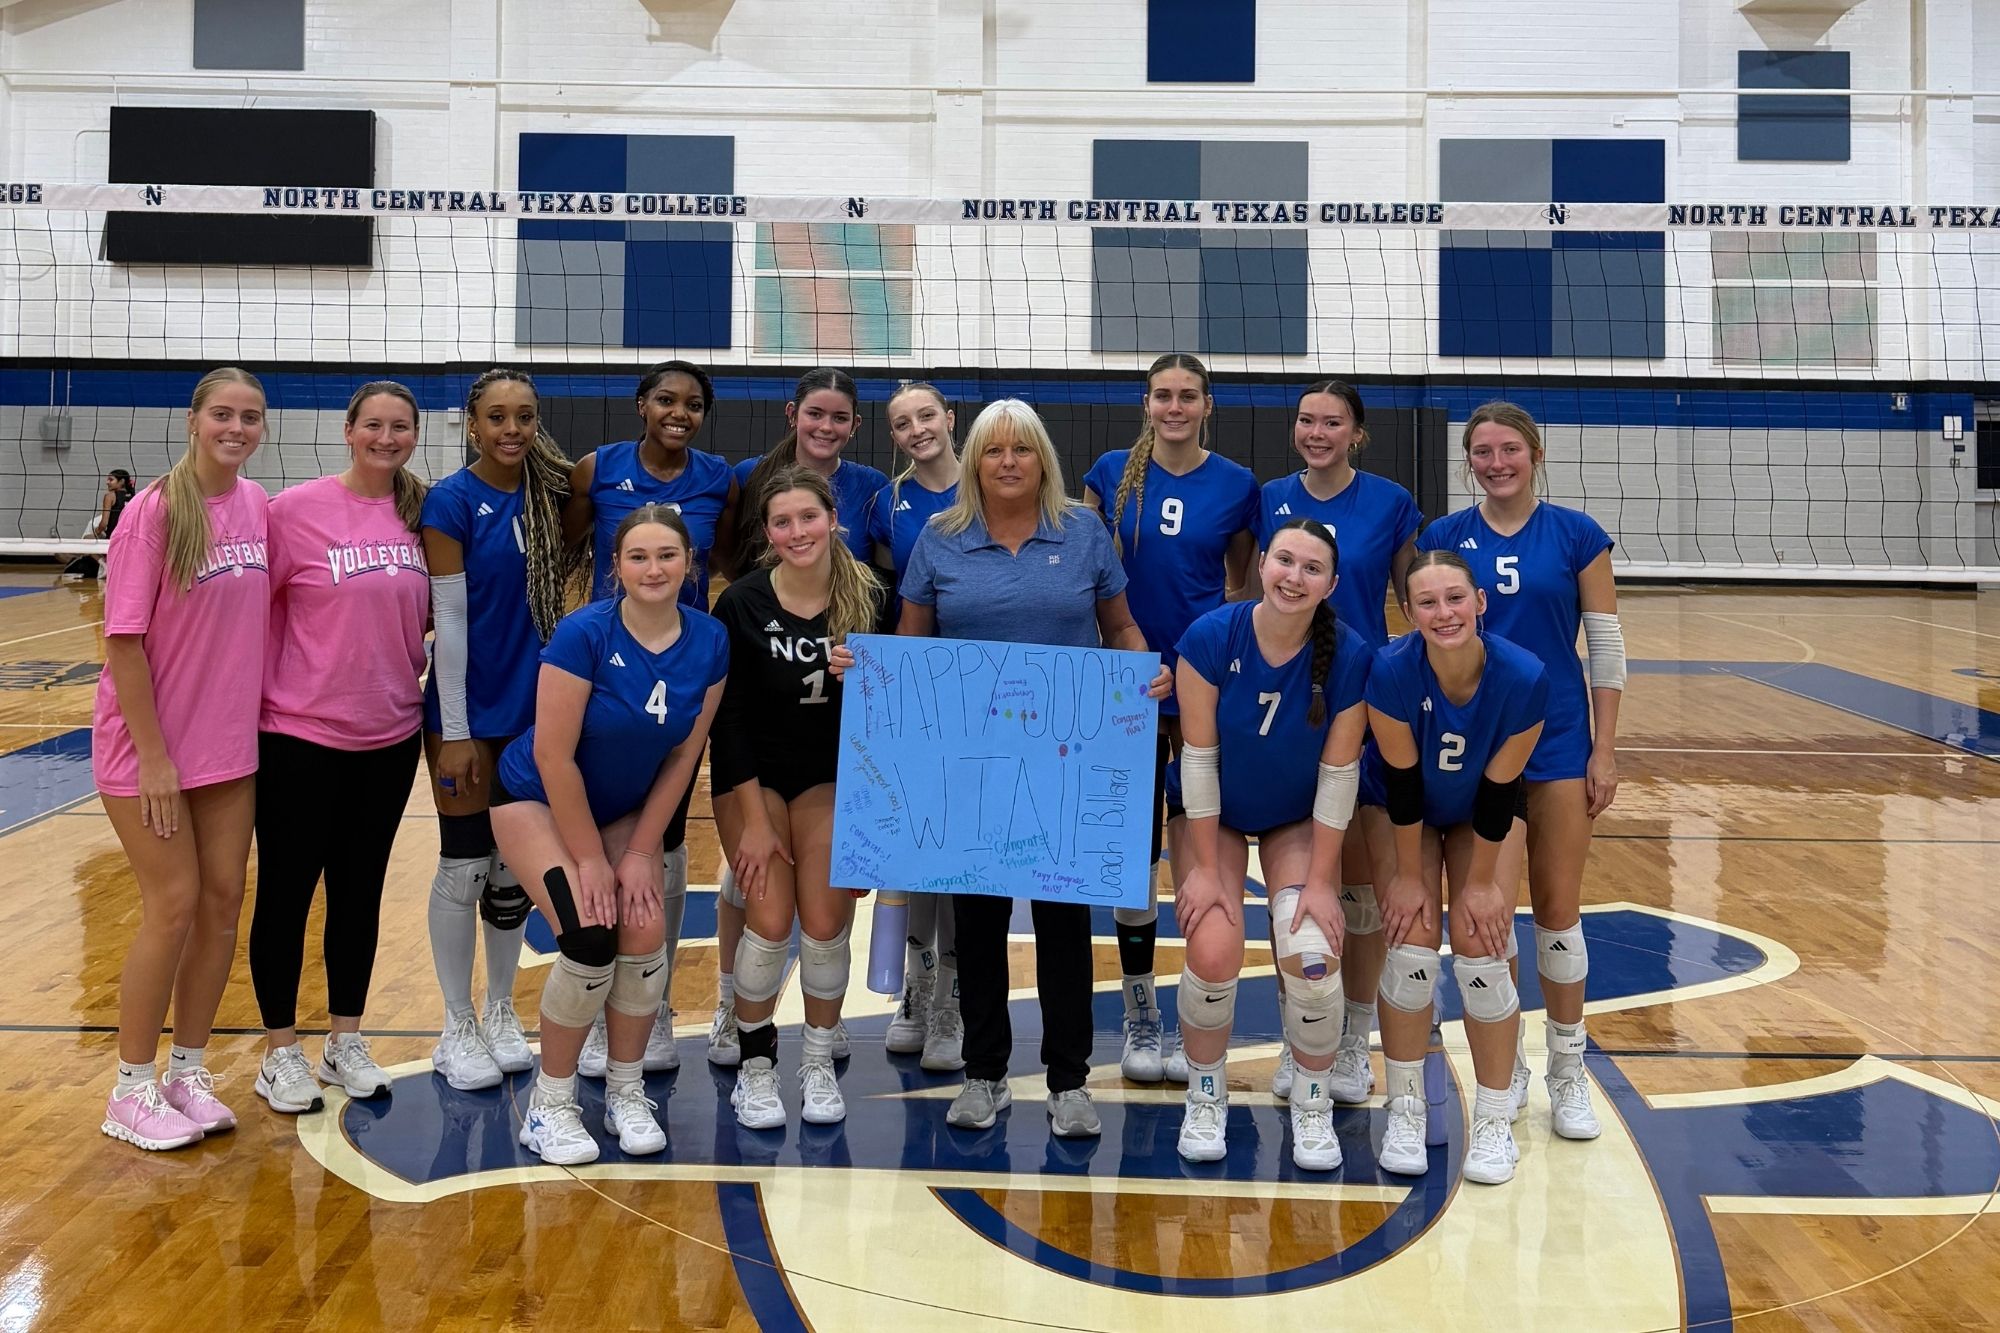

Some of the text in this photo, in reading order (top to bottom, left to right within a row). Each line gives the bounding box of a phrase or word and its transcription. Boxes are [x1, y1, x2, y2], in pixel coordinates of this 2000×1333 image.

[263, 188, 747, 217] NORTH CENTRAL TEXAS COLLEGE
[962, 199, 1443, 225] NORTH CENTRAL TEXAS COLLEGE
[1668, 203, 1768, 226] NORTH
[1778, 205, 1916, 228] CENTRAL
[1160, 498, 1184, 535] 9
[1496, 555, 1520, 595] 5
[645, 680, 667, 724] 4
[800, 669, 829, 704] 1
[862, 643, 1010, 740] HAPPY
[1258, 692, 1281, 736] 7
[1438, 733, 1466, 771] 2
[1077, 765, 1131, 898] Coach Bullard
